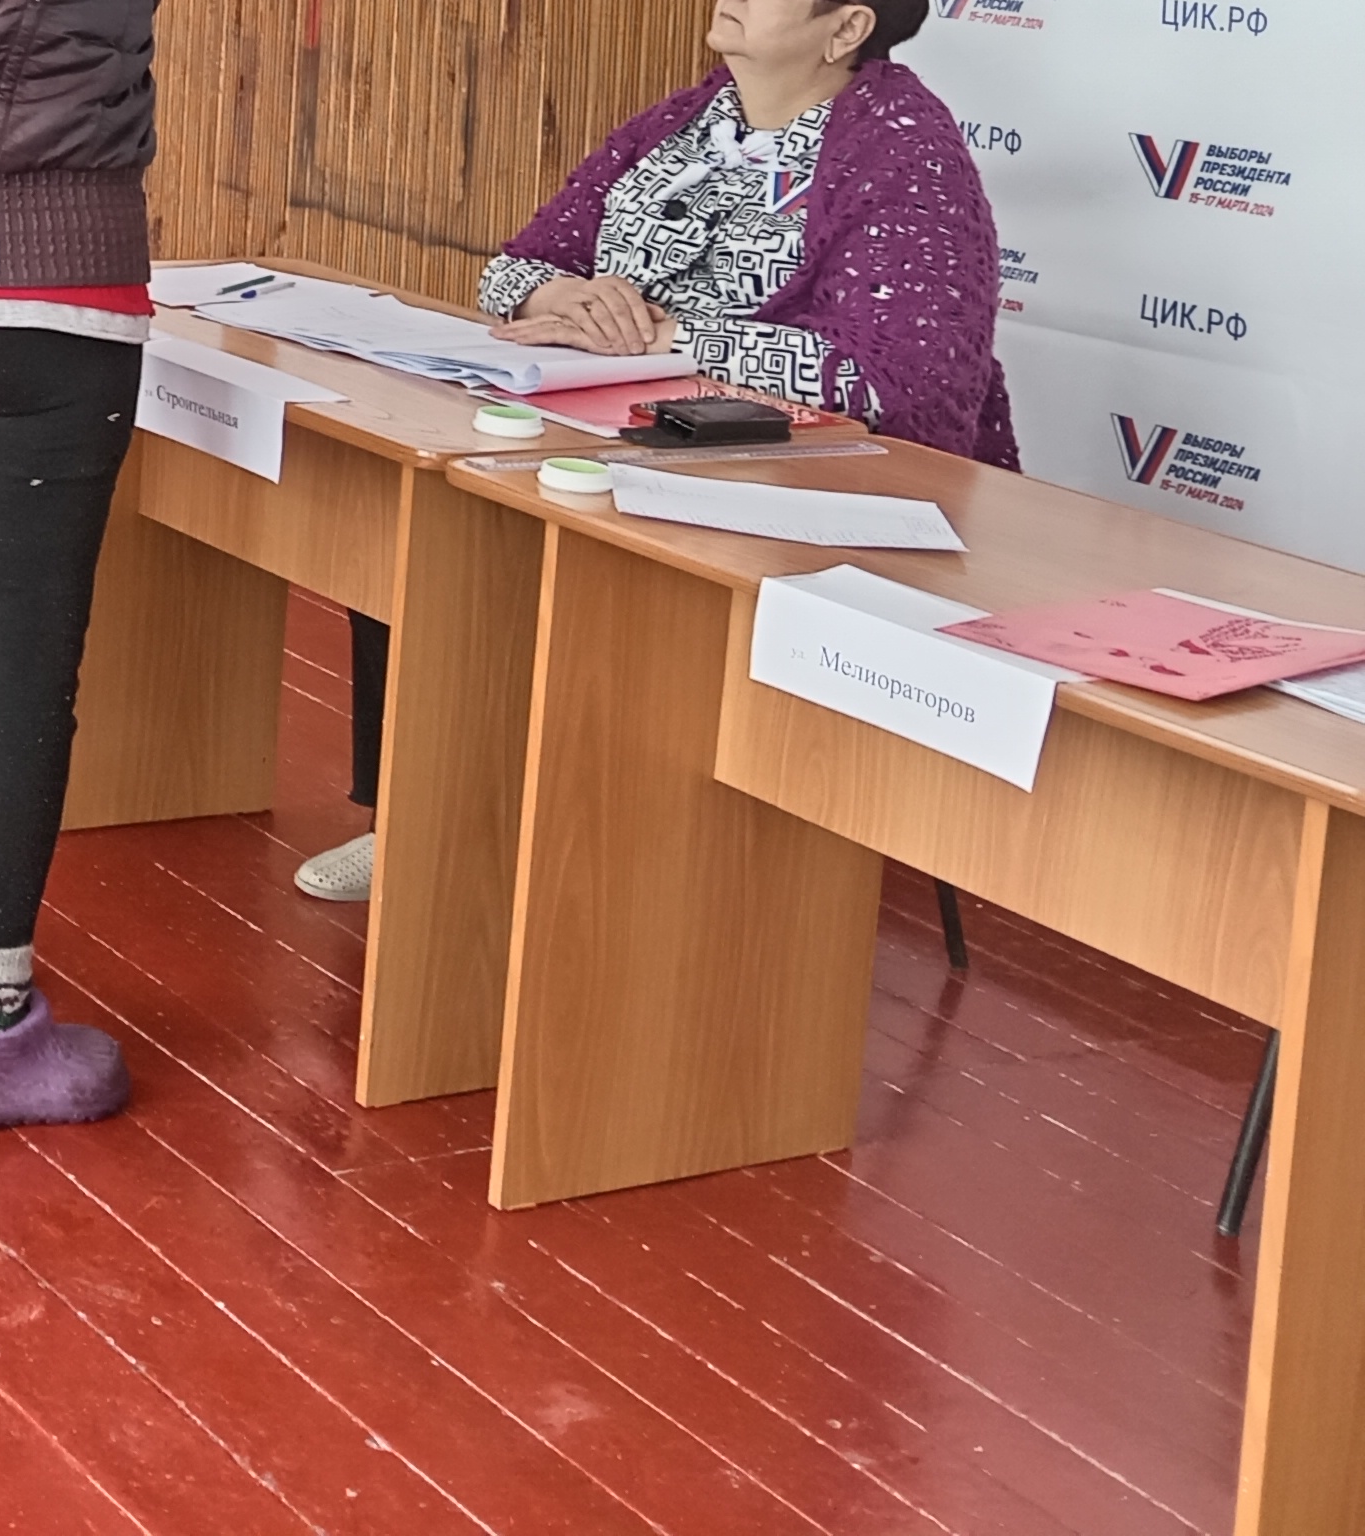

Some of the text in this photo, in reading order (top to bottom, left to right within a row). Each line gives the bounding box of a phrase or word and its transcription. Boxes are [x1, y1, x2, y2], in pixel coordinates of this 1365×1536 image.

[959, 121, 1022, 156] К.РФ
[1206, 144, 1272, 165] ВЫБОРЫ
[1193, 176, 1252, 197] РОССИИ
[1200, 160, 1292, 186] ПРЕЗИДЕНТА
[1139, 294, 1248, 341] ЦИК.РФ
[156, 384, 239, 429] Строительная
[1181, 432, 1246, 459] ВЫБОРЫ
[1165, 464, 1222, 489] РОССИИ
[1173, 448, 1262, 482] ПРЕЗИДЕНТА
[819, 645, 976, 724] Мелиораторов
